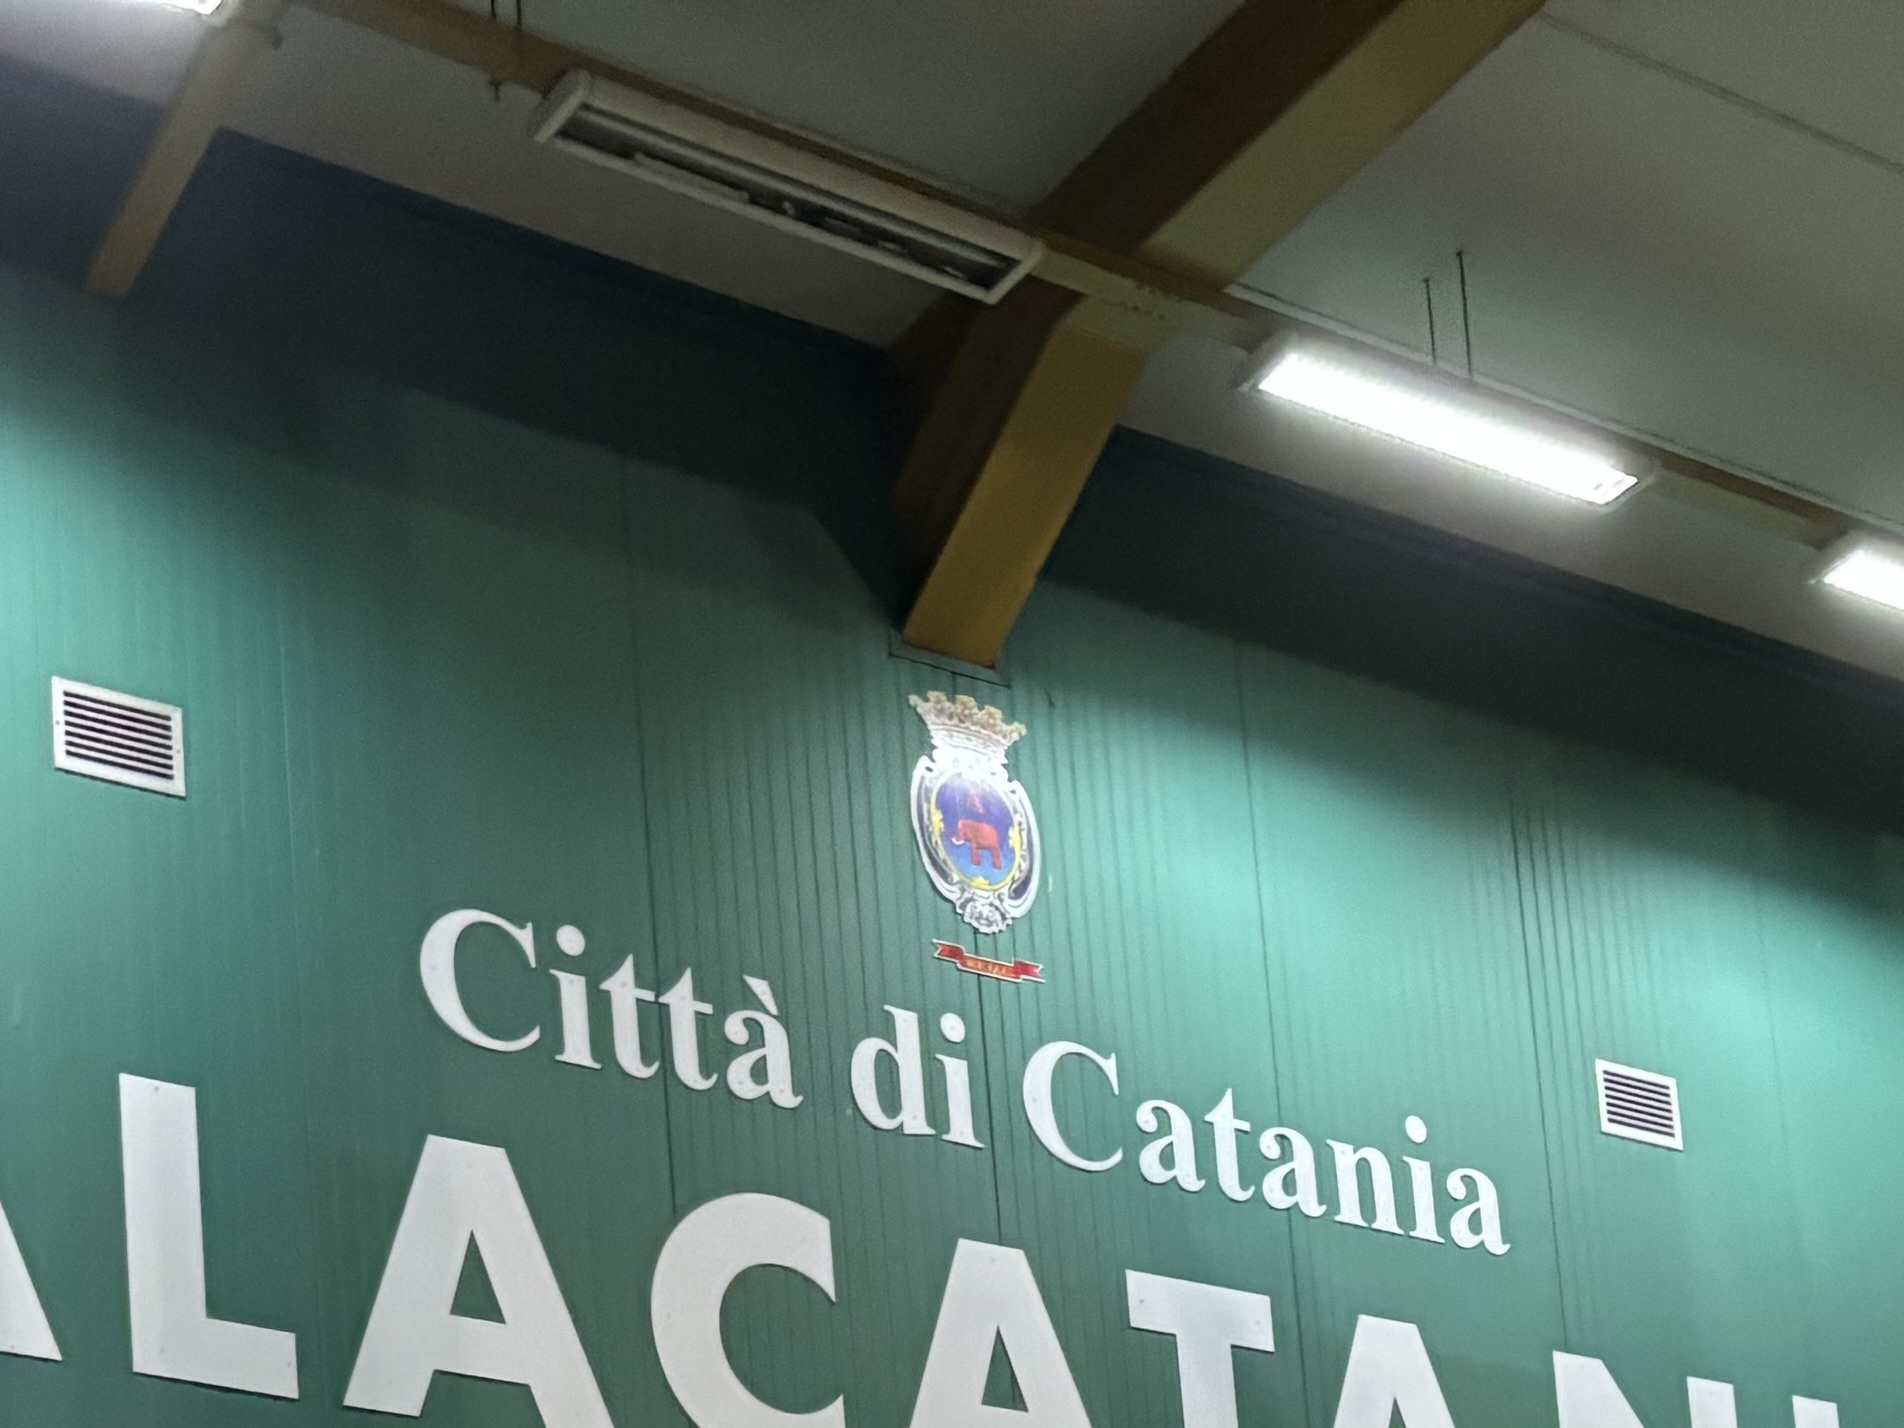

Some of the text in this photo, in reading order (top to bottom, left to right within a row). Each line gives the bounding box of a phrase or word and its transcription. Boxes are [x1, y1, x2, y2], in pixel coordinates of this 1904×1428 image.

[419, 908, 1512, 1260] Città di Catania
